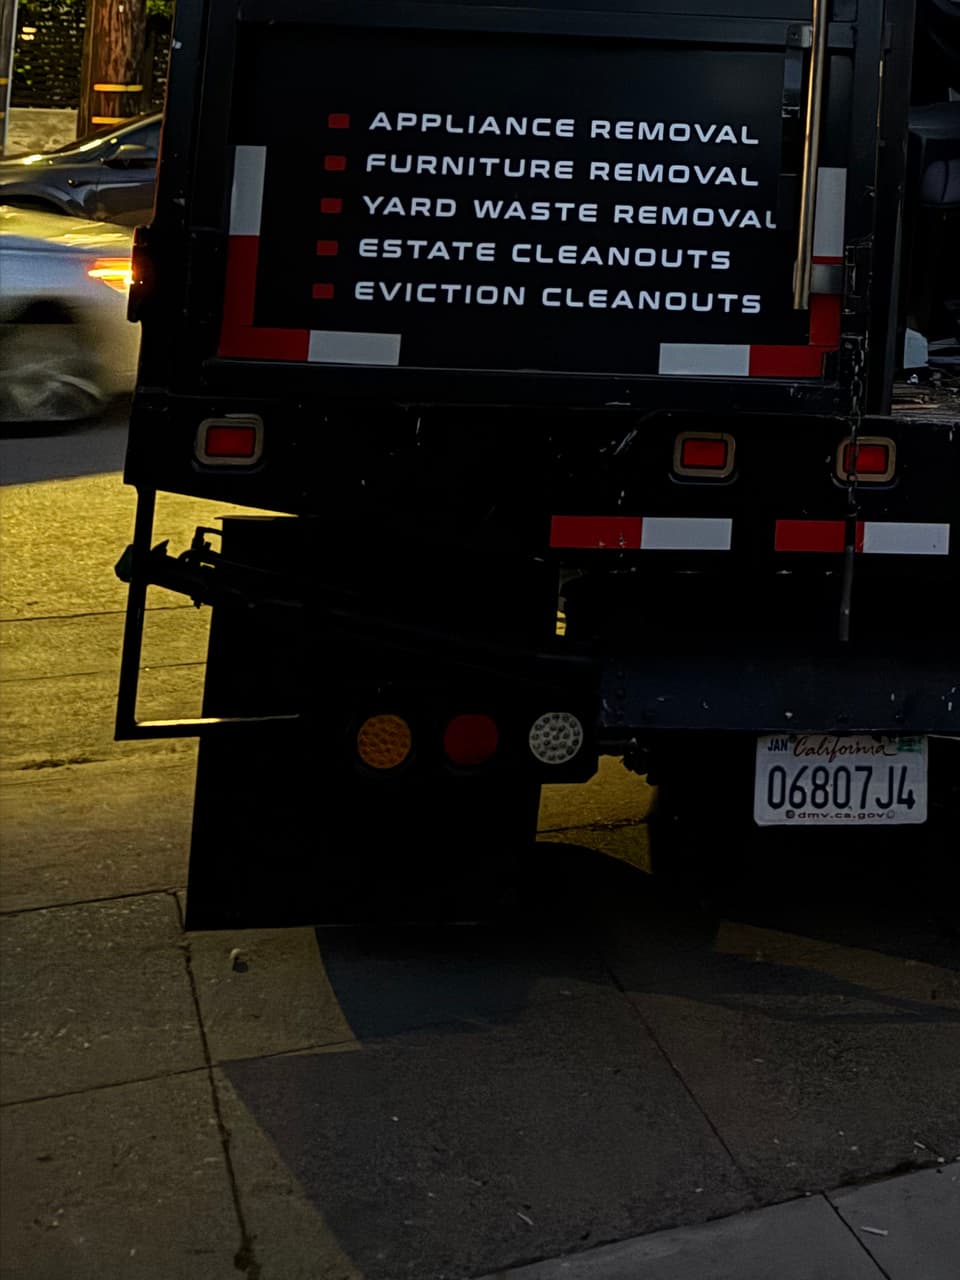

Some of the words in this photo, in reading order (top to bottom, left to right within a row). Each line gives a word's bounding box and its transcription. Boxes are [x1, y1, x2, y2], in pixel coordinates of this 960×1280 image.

[368, 111, 575, 138] APPLIANCE
[590, 119, 759, 145] REMOVAL
[366, 153, 574, 180] FURNITURE
[589, 161, 759, 187] REMOVAL
[362, 195, 457, 218] YARD
[473, 199, 598, 223] WASTE
[613, 204, 777, 229] REMOVAL
[358, 238, 496, 262] ESTATE
[511, 243, 731, 270] CLEANOUTS
[354, 281, 526, 306] EVICTION
[542, 287, 761, 314] CLEANOUTS
[767, 738, 789, 752] JAN
[793, 735, 897, 763] California
[767, 765, 916, 811] 06807J4
[797, 810, 886, 820] dmv.ca.gov
